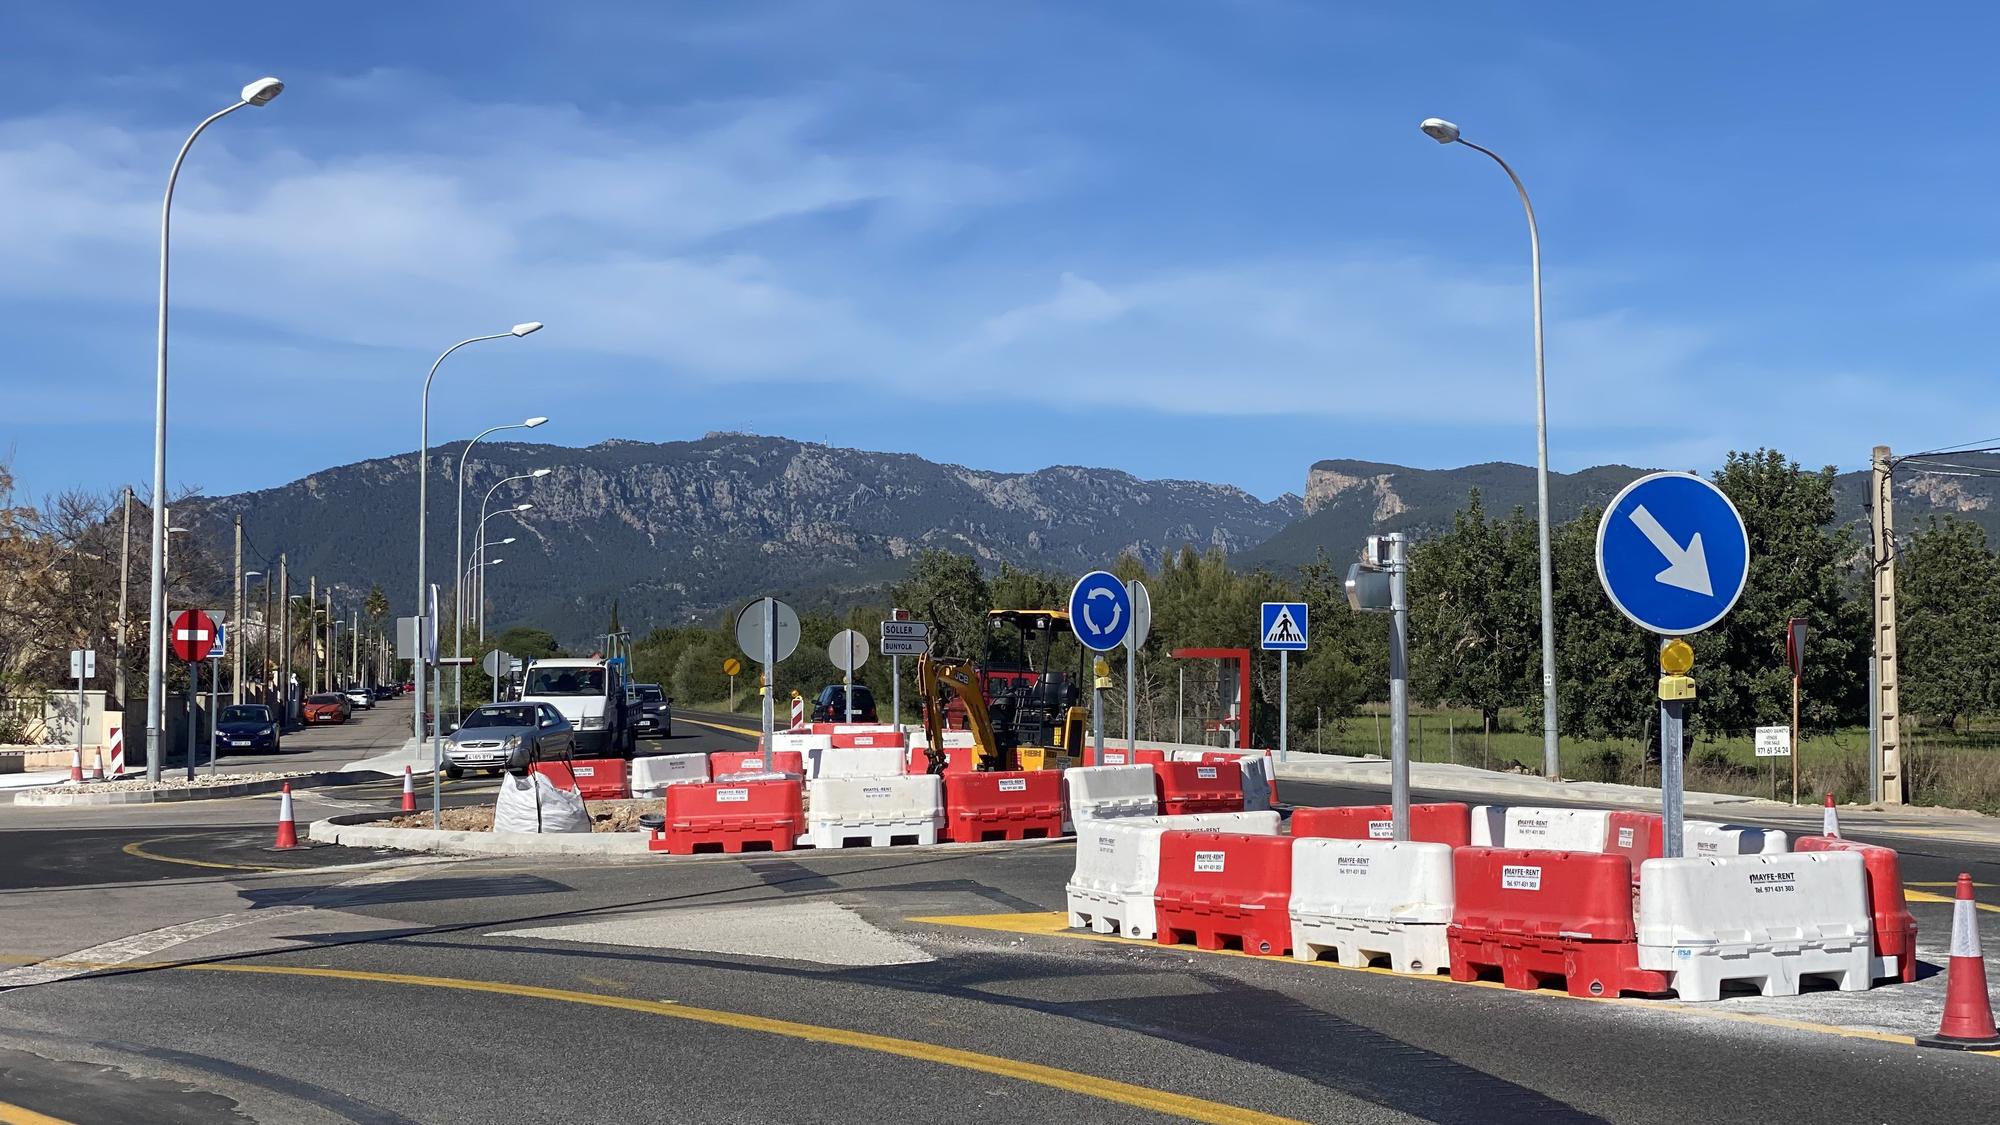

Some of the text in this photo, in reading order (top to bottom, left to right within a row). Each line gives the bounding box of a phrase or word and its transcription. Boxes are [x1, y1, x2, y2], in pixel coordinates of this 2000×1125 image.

[954, 671, 969, 684] JCB
[1774, 746, 1781, 754] 54
[1781, 746, 1789, 754] 24
[1504, 868, 1540, 876] MAYFE-RENT
[1749, 872, 1795, 883] MAYFE-RENT
